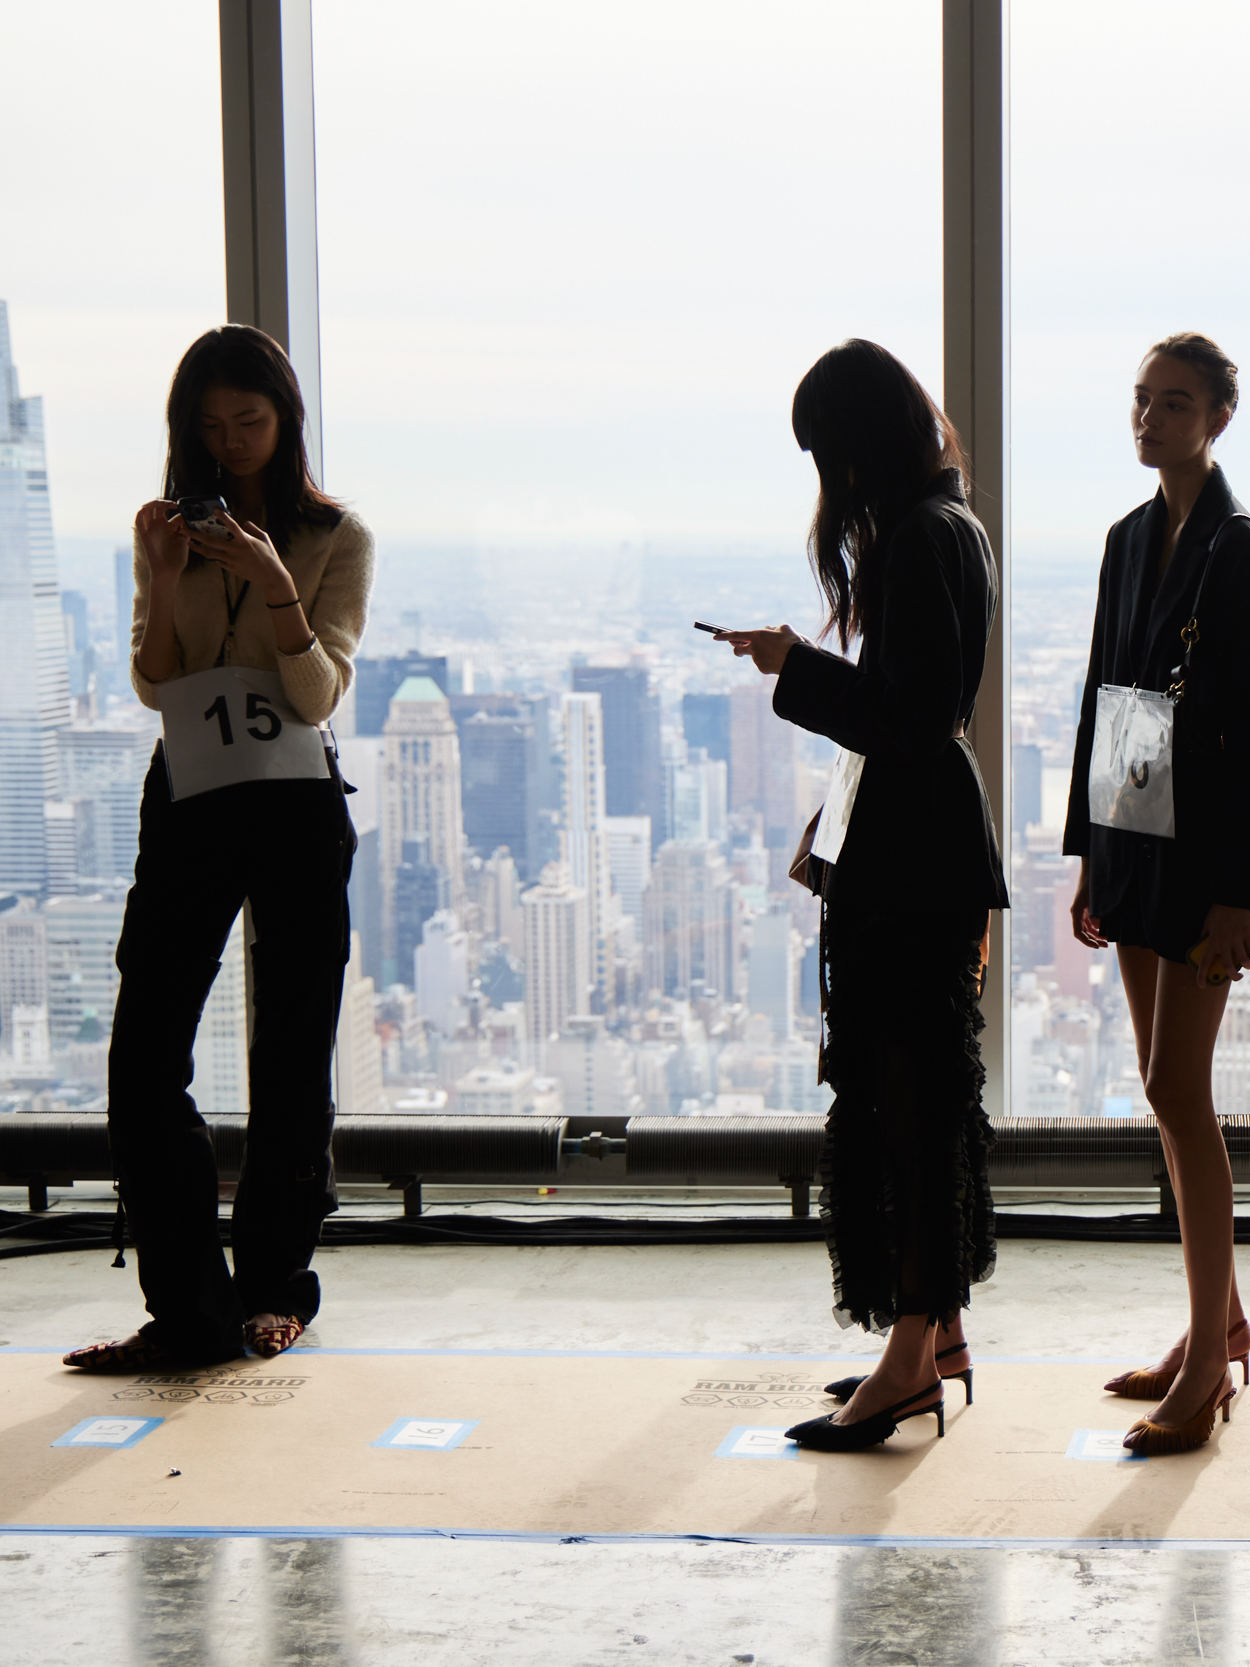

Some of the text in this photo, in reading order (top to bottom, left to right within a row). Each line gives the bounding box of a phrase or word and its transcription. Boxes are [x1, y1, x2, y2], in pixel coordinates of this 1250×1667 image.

[203, 692, 282, 746] 15
[133, 1376, 307, 1387] RAM BOARD
[694, 1381, 825, 1393] RAM BOA
[89, 1424, 128, 1436] 15
[408, 1427, 446, 1440] 16
[746, 1434, 780, 1447] 17
